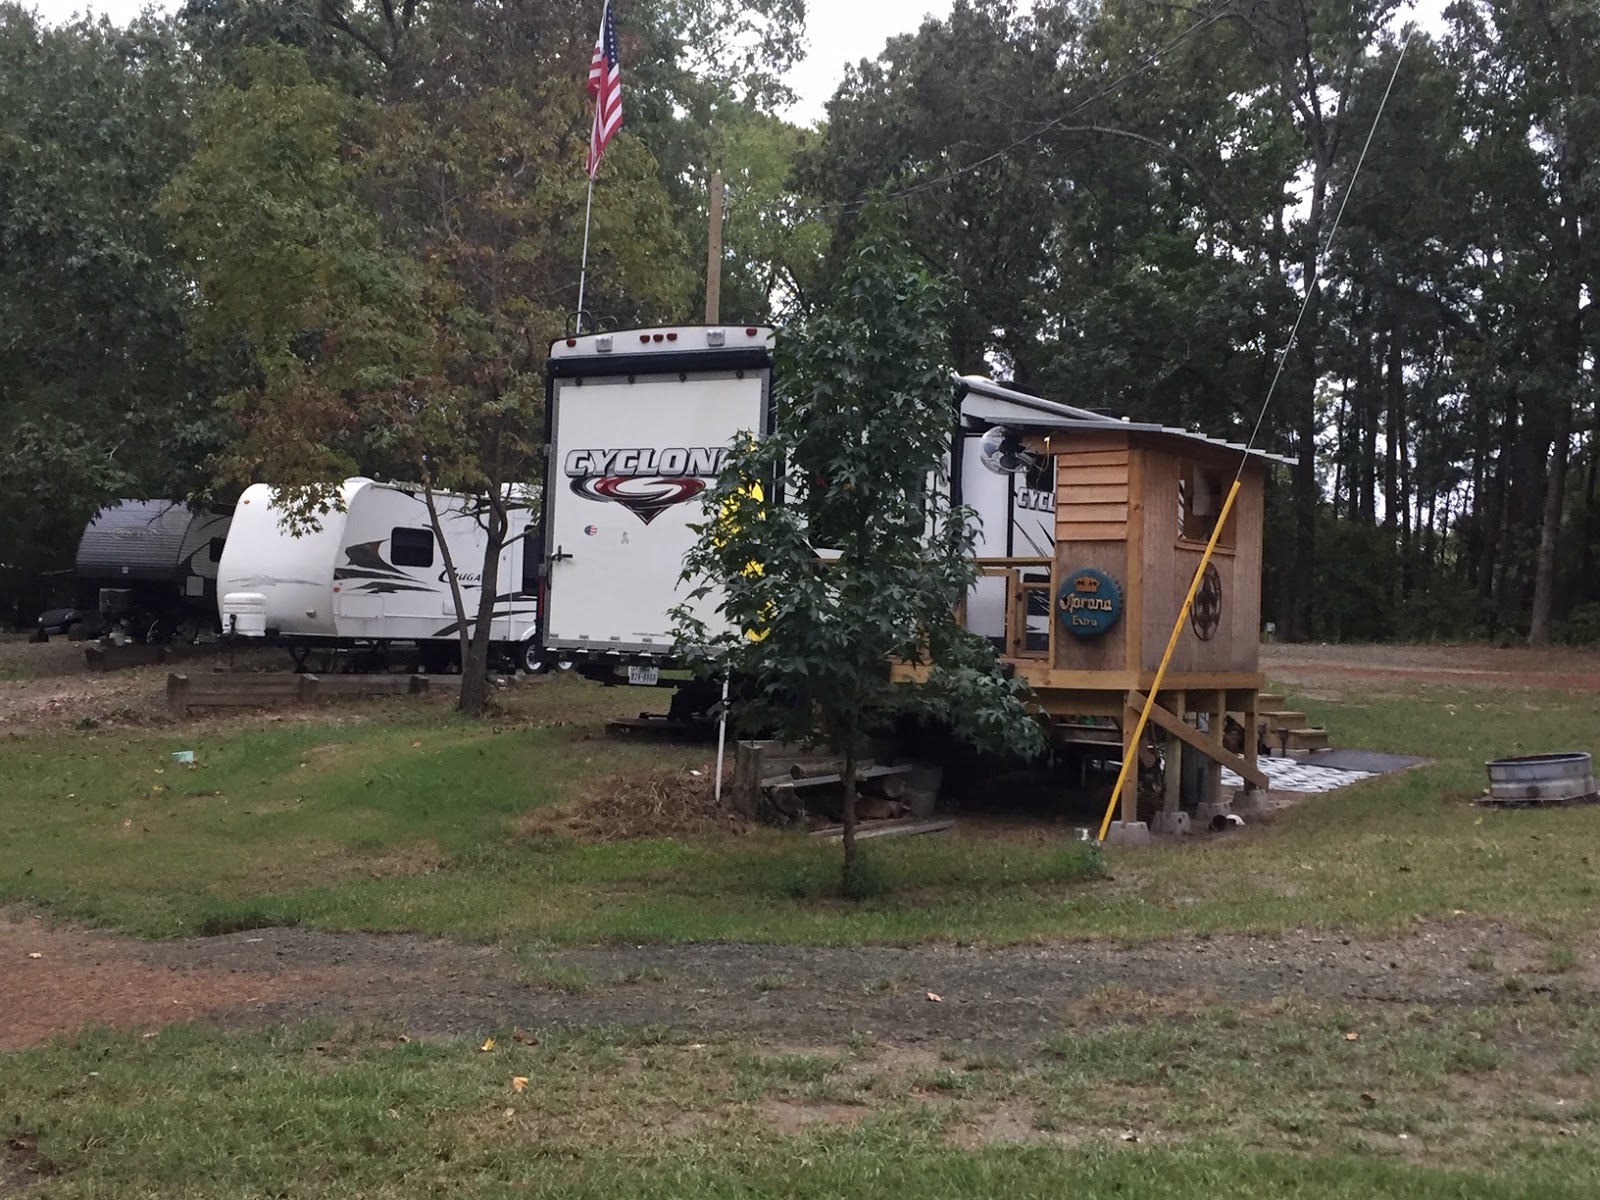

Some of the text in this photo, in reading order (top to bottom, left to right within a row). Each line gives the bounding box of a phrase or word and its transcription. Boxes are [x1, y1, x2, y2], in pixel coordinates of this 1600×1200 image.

[438, 567, 481, 584] CUGA
[1060, 593, 1112, 613] Corona
[1072, 615, 1098, 627] Extra
